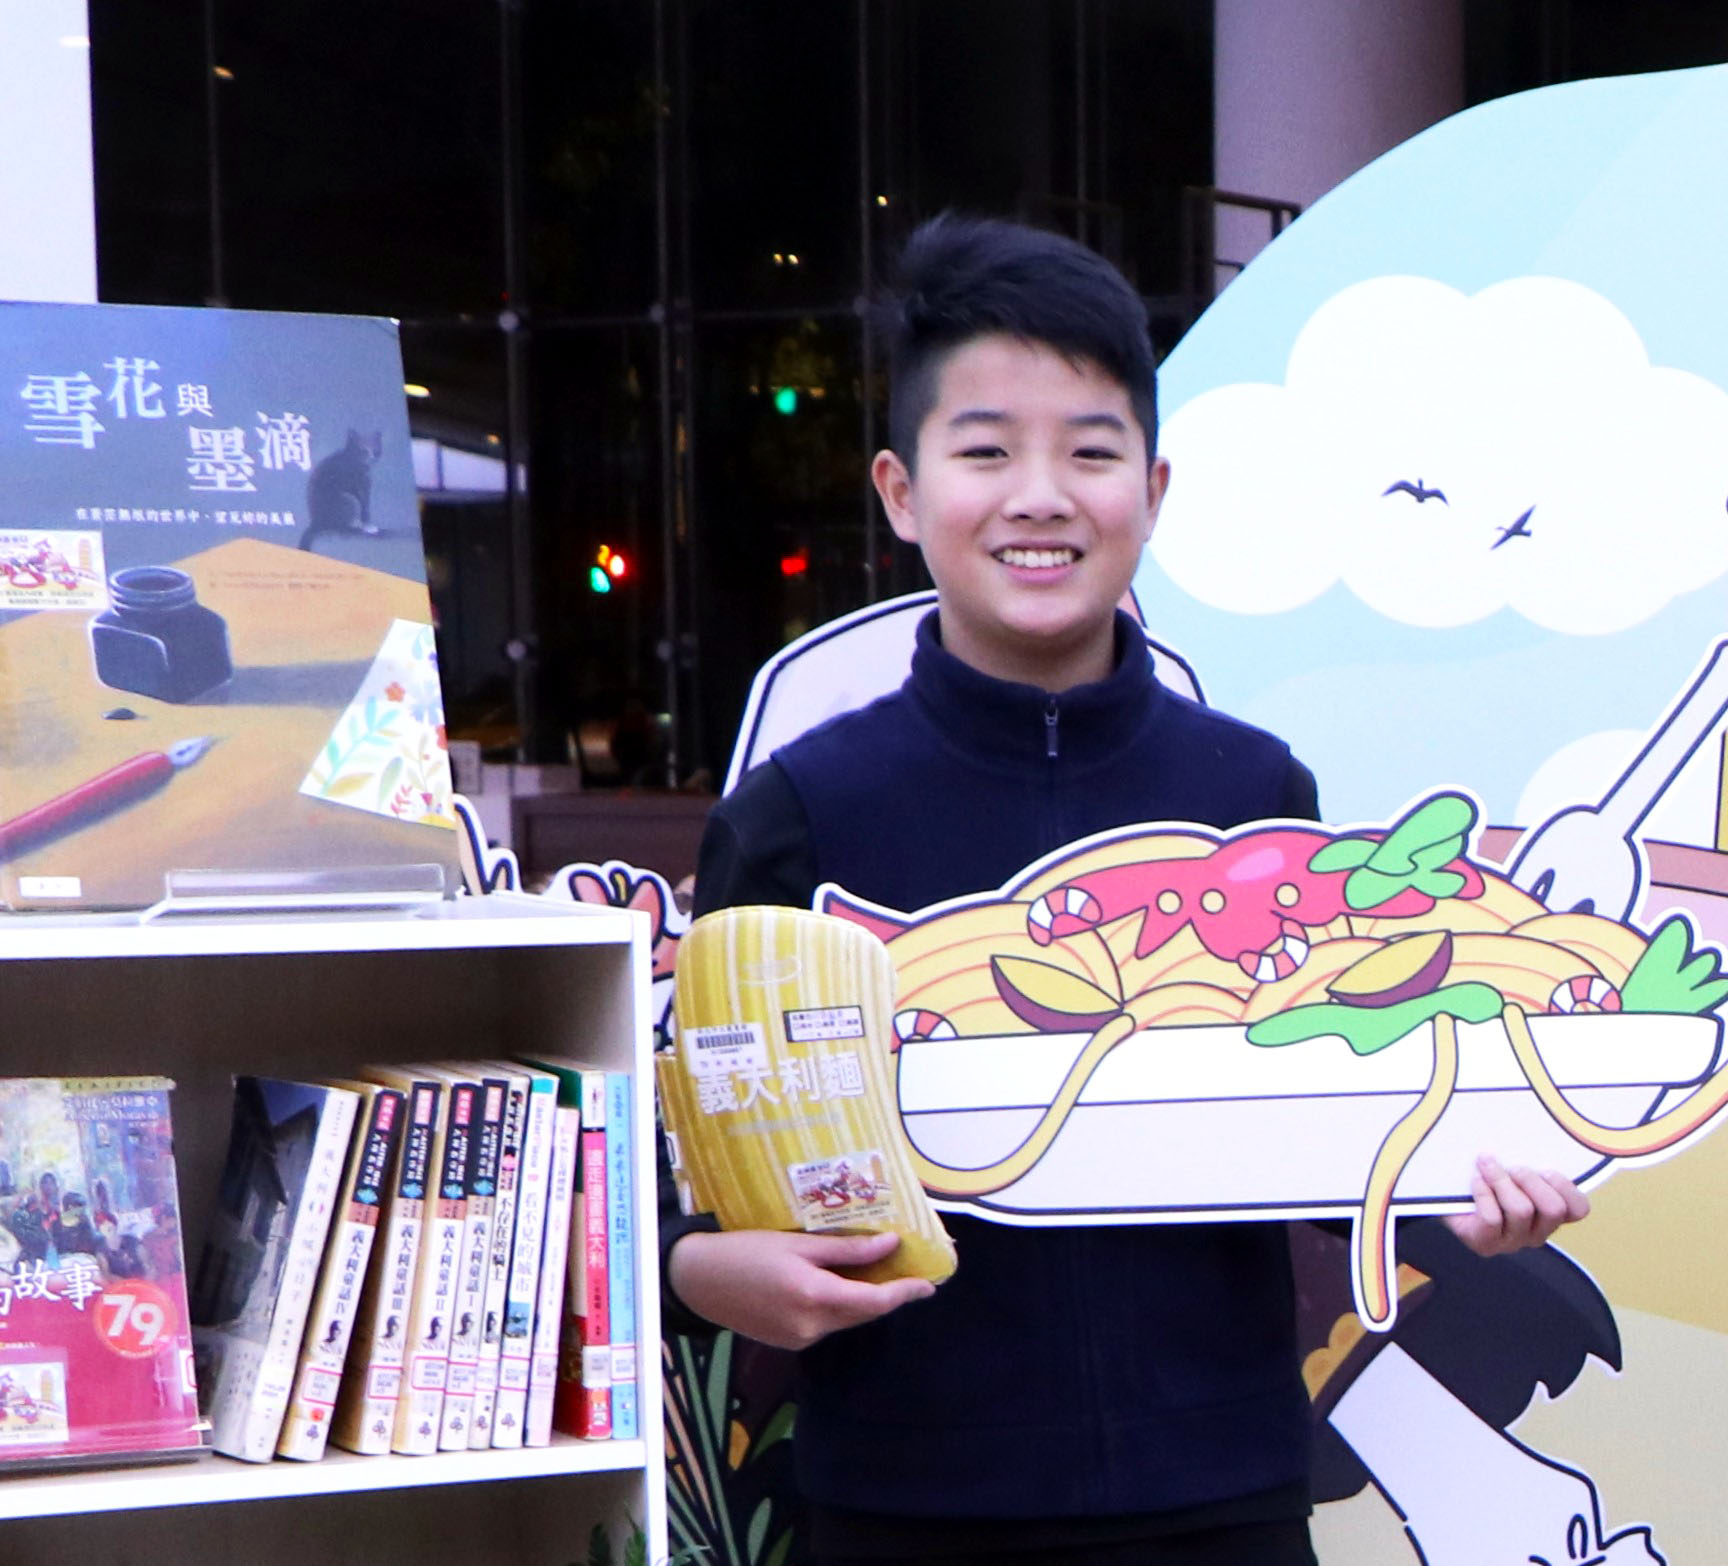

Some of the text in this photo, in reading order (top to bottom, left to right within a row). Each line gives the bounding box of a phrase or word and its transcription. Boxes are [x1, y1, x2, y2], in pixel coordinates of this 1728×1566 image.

[20, 356, 214, 450] 雪花與
[186, 411, 312, 492] 墨滴
[696, 1051, 866, 1116] 義大利麵
[102, 1293, 165, 1347] 79
